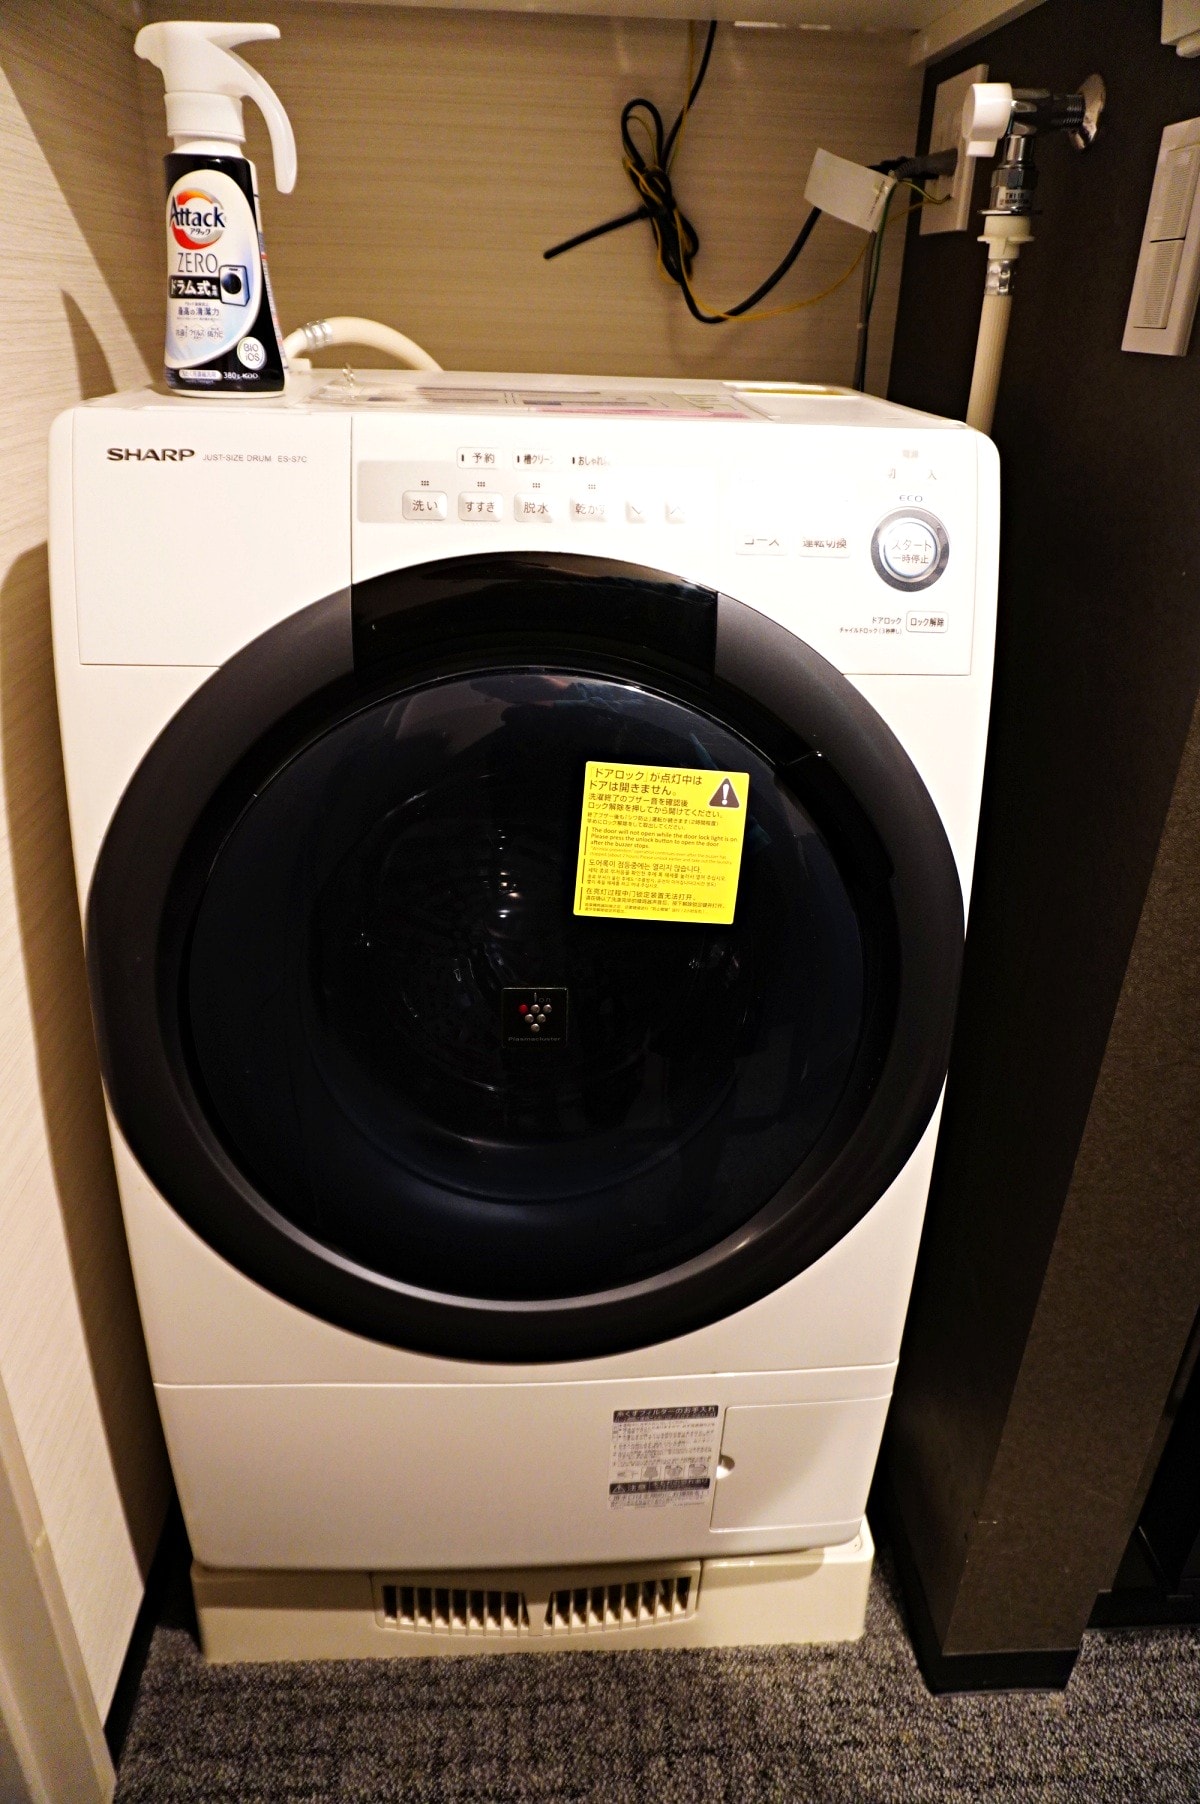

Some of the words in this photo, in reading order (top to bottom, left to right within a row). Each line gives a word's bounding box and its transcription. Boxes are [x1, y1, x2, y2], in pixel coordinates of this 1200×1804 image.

[170, 195, 225, 228] Attack
[178, 253, 218, 273] ZERO
[106, 448, 195, 461] SHARP
[202, 453, 244, 462] JUST-SIZE
[246, 454, 272, 462] DRUM
[277, 455, 308, 463] ES-S7C
[472, 452, 495, 464] 予約
[412, 500, 438, 512] 洗い
[465, 501, 495, 513] すすぎ
[523, 502, 549, 514] 脱水
[892, 538, 932, 551] スタート
[893, 554, 929, 564] 一時停止
[872, 616, 902, 625] ドアロック
[910, 617, 944, 627] ロック解除
[590, 767, 702, 785] 「ドアロック」が点灯中は
[589, 780, 677, 796] ドアは開きません。
[588, 793, 688, 806] 洗濯終了のブザー音を確認後
